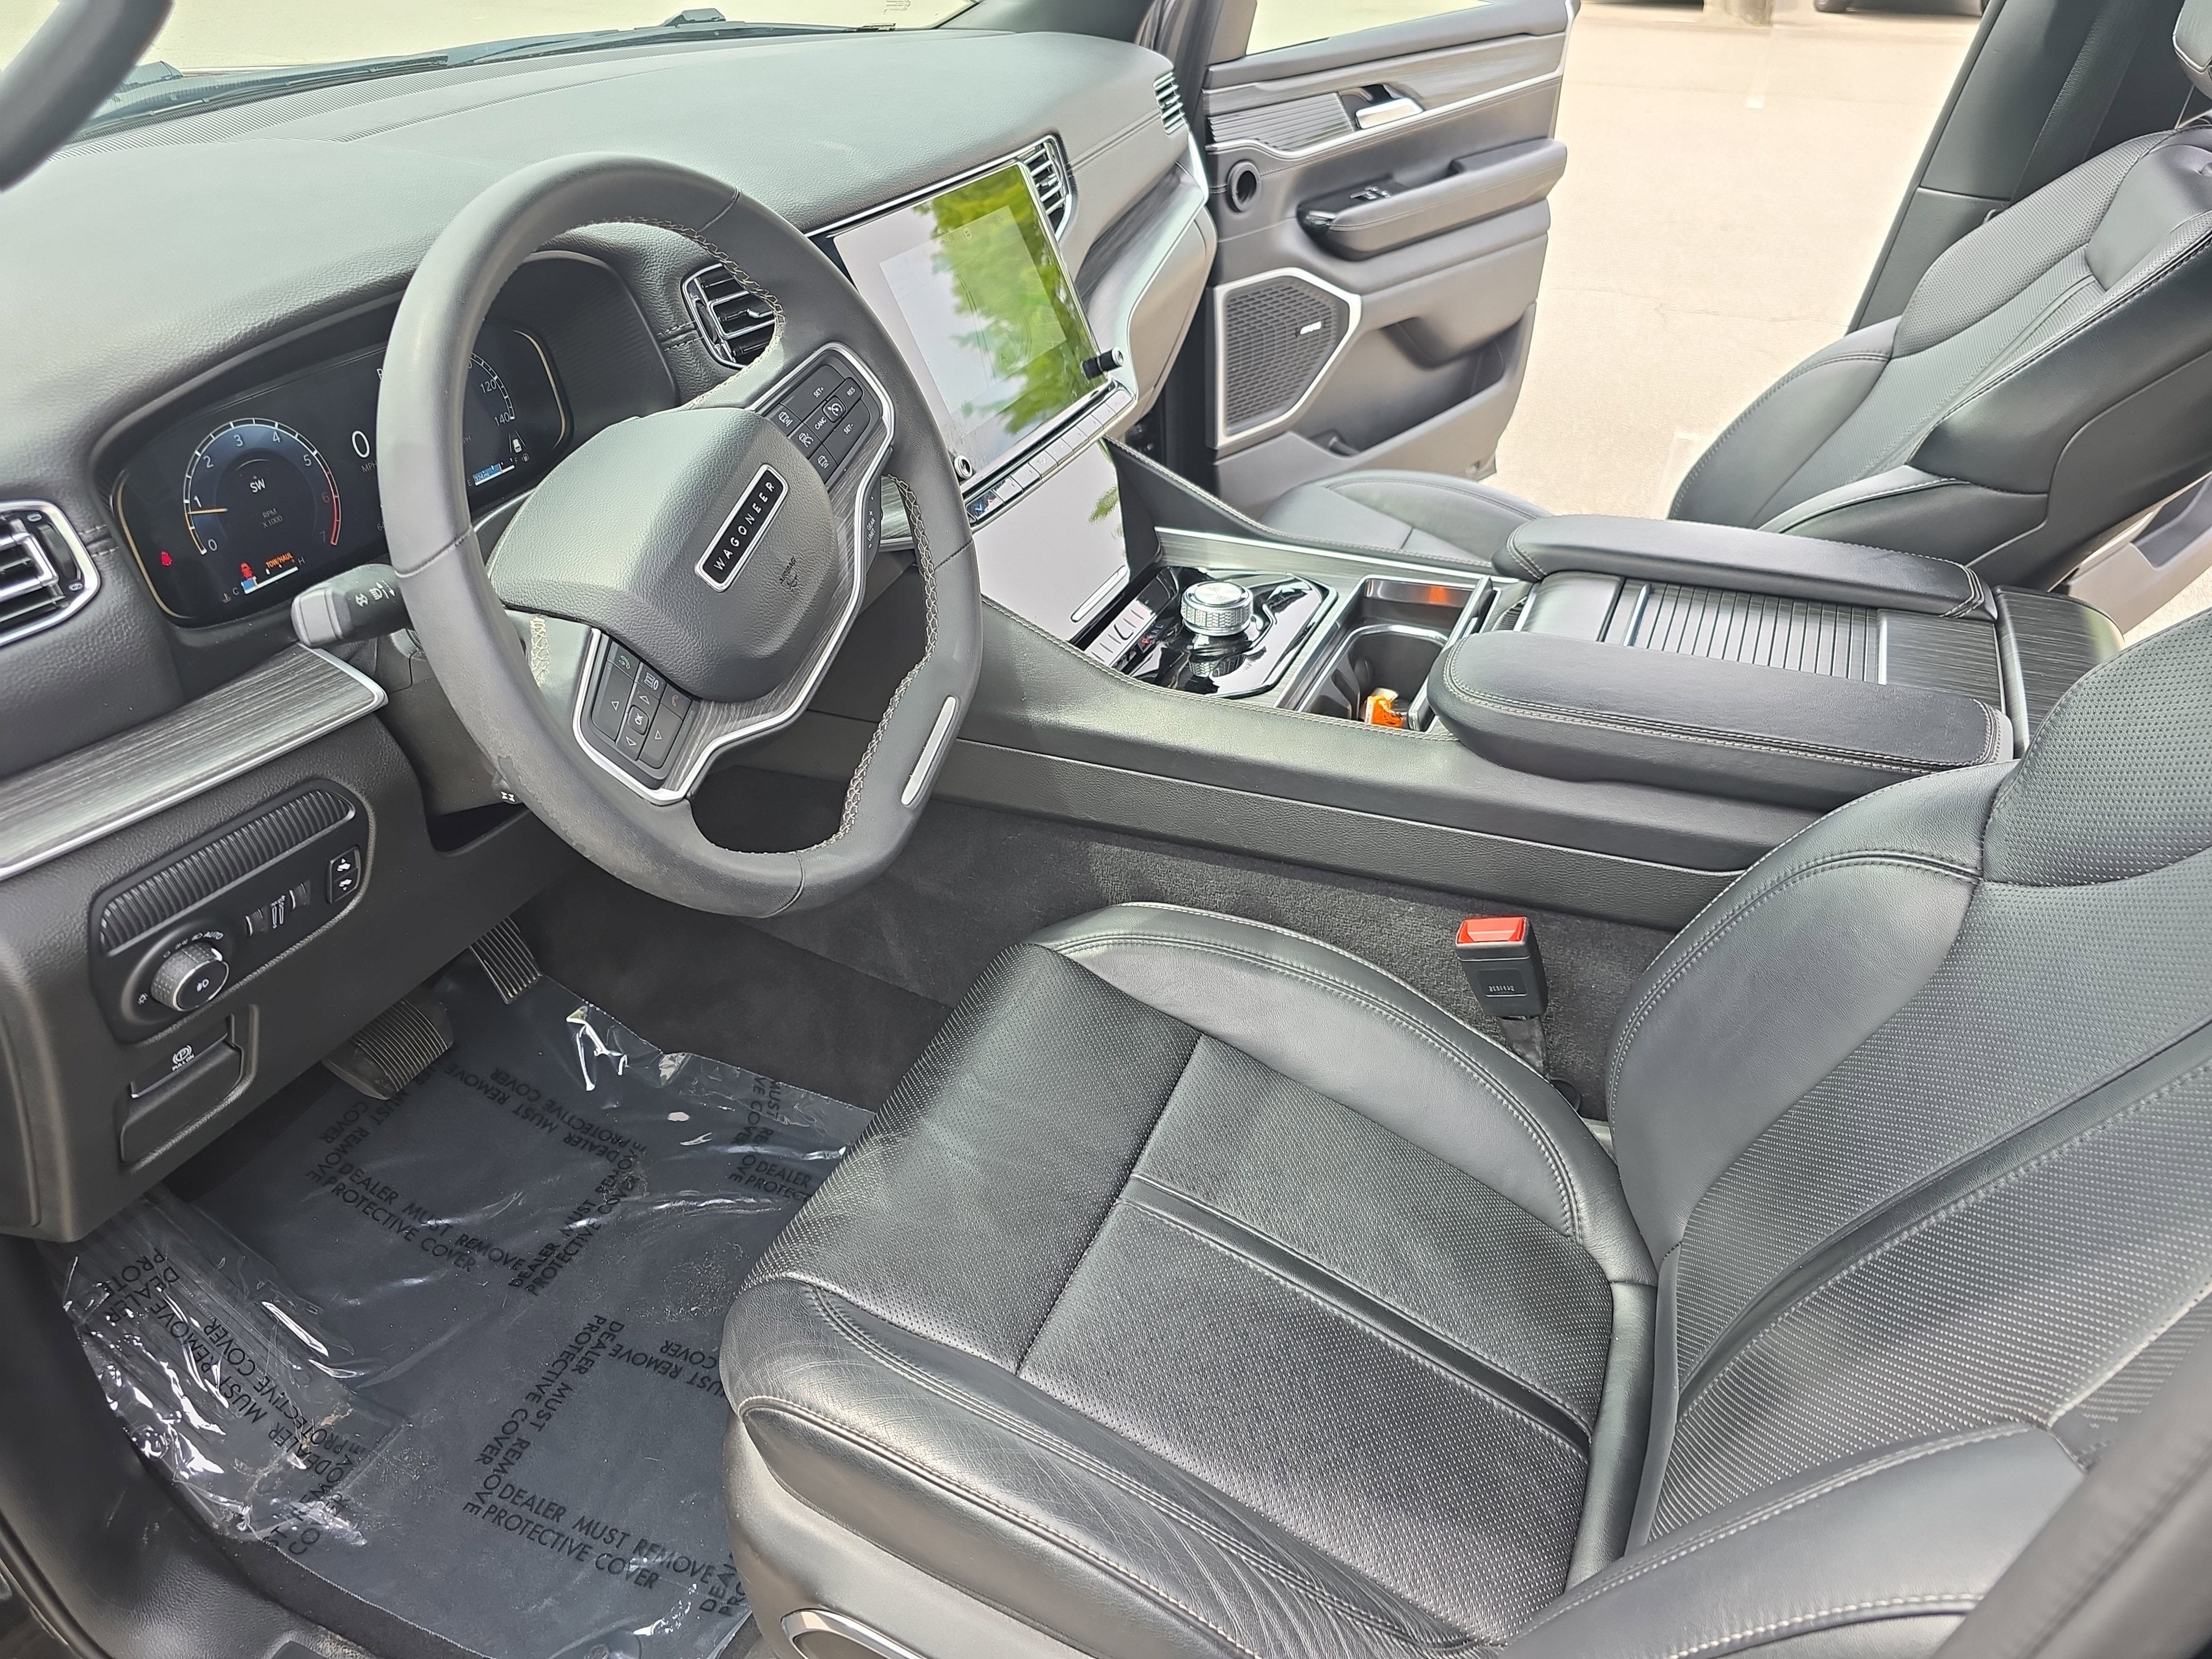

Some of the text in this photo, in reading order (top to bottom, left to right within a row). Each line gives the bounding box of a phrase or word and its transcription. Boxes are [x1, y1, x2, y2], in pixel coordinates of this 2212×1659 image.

[480, 379, 497, 393] 120
[846, 387, 856, 397] RES
[494, 411, 510, 426] 140
[814, 416, 827, 430] CANC
[233, 434, 243, 447] 3
[272, 431, 281, 443] 4
[352, 430, 370, 458] 0
[203, 455, 214, 468] 2
[303, 454, 312, 467] 5
[250, 478, 266, 493] SW
[194, 494, 202, 508] 1
[262, 508, 278, 519] RPM
[713, 481, 775, 570] WAGONEER
[208, 539, 217, 551] 0
[265, 552, 293, 568] TOW/HAUL
[298, 556, 305, 565] H
[232, 587, 239, 595] C
[634, 712, 644, 725] OK
[444, 1063, 510, 1105] REMOVE
[490, 1068, 541, 1102] COVER
[513, 1103, 558, 1134] MUST
[755, 1161, 812, 1188] DEALER
[323, 1176, 475, 1272] PROTECTIVE COVER
[338, 1163, 399, 1205] DEALER
[454, 1233, 526, 1270] REMOVE
[203, 1318, 256, 1376] COVER
[659, 1340, 717, 1369] COVER
[608, 1343, 726, 1398] UST REMOVE
[219, 1375, 267, 1424] MUST
[474, 1315, 607, 1465] PROTECTIVE COVER
[462, 1321, 625, 1516] DEALER MUST REMOVE
[497, 1483, 567, 1523] DEALER
[571, 1515, 631, 1549] MUST
[481, 1504, 594, 1562] PROTECTIVE
